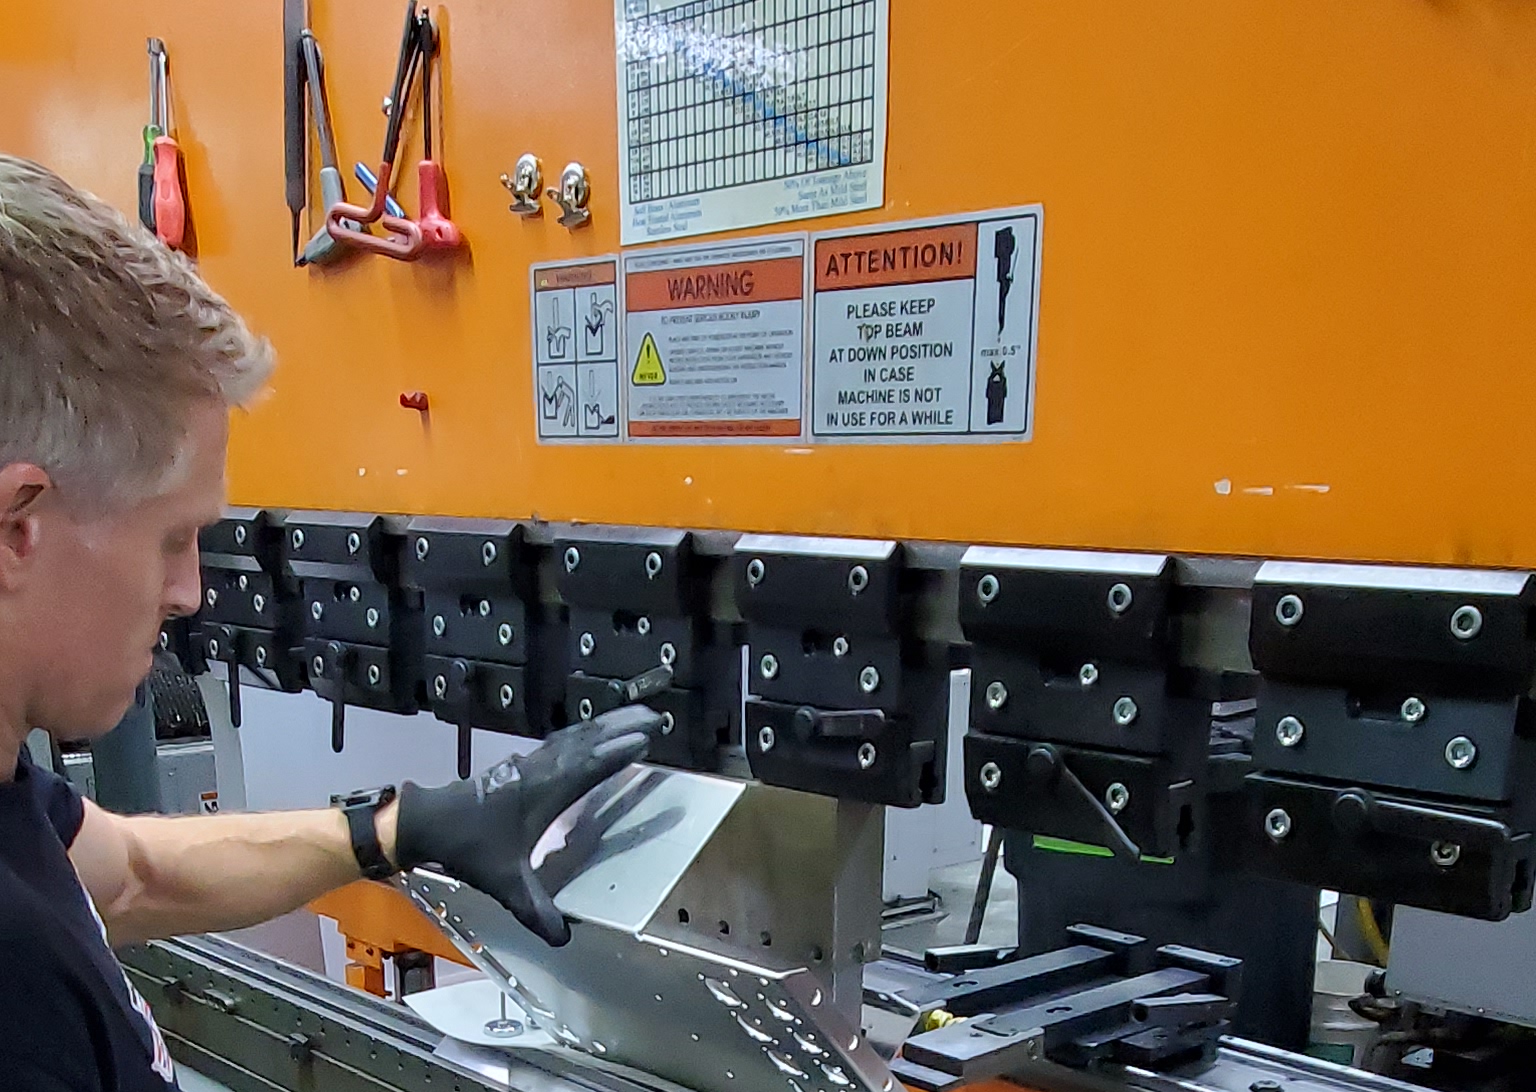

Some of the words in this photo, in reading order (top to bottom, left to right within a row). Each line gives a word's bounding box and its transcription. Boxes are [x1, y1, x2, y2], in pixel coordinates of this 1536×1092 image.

[825, 241, 962, 276] ATTENTION!
[667, 270, 755, 300] WARNING
[847, 301, 896, 319] PLEASE
[900, 298, 935, 315] KEEP
[857, 323, 882, 341] TOP
[885, 322, 923, 339] BEAM
[829, 348, 845, 363] AT
[848, 346, 886, 362] DOWN
[891, 342, 953, 359] POSITION
[864, 368, 876, 383] IN
[879, 366, 915, 382] CASE
[838, 389, 895, 405] MACHINE
[898, 389, 910, 403] IS
[914, 387, 942, 403] NOT
[827, 412, 839, 426] IN
[842, 412, 865, 427] USE
[870, 411, 896, 426] FOR
[898, 411, 908, 425] A
[911, 410, 954, 425] WHILE
